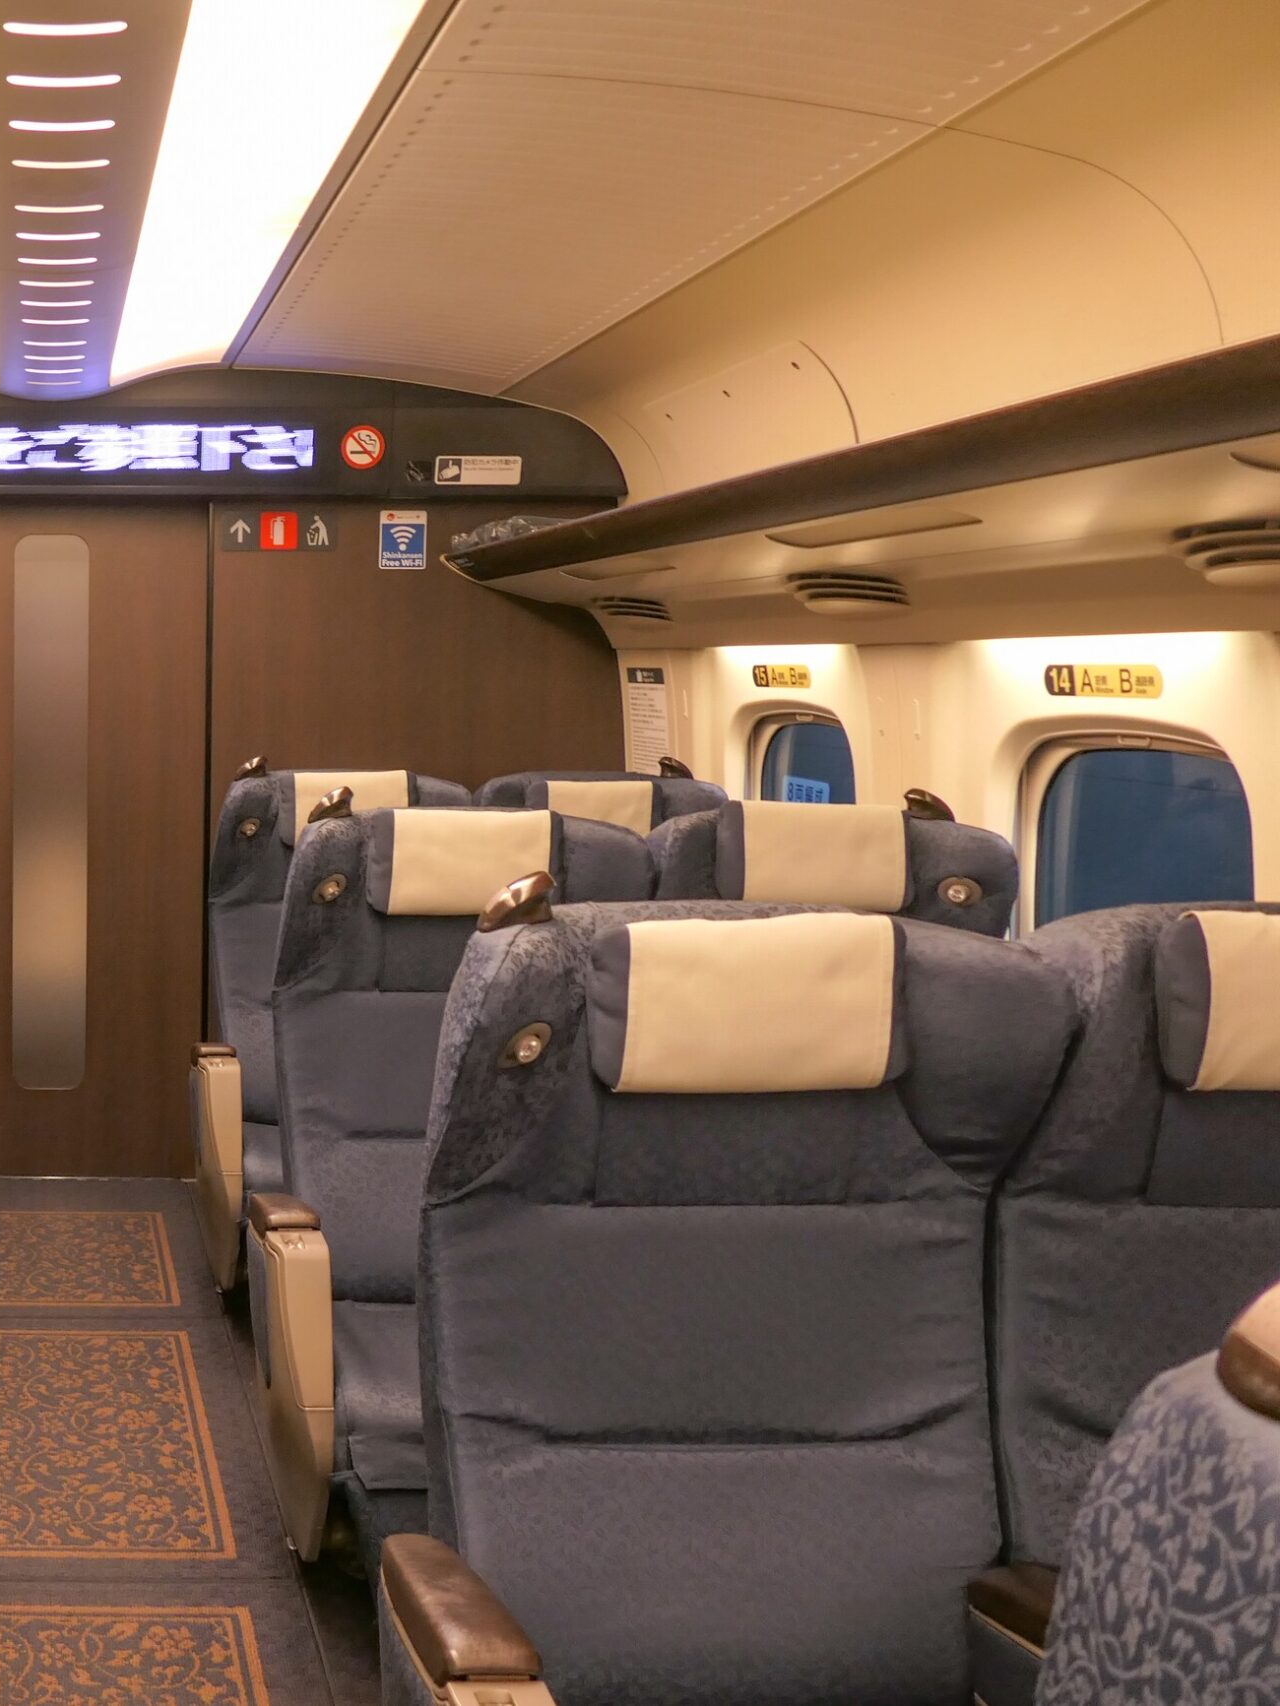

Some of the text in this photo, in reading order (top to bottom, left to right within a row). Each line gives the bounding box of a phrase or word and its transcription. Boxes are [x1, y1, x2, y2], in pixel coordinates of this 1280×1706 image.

[382, 551, 423, 559] Shinkansen
[381, 559, 423, 567] Free Wi-Fi
[755, 667, 767, 686] 15
[789, 667, 797, 685] B
[1049, 667, 1071, 693] 14
[1080, 668, 1094, 693] A
[1119, 669, 1133, 693] B
